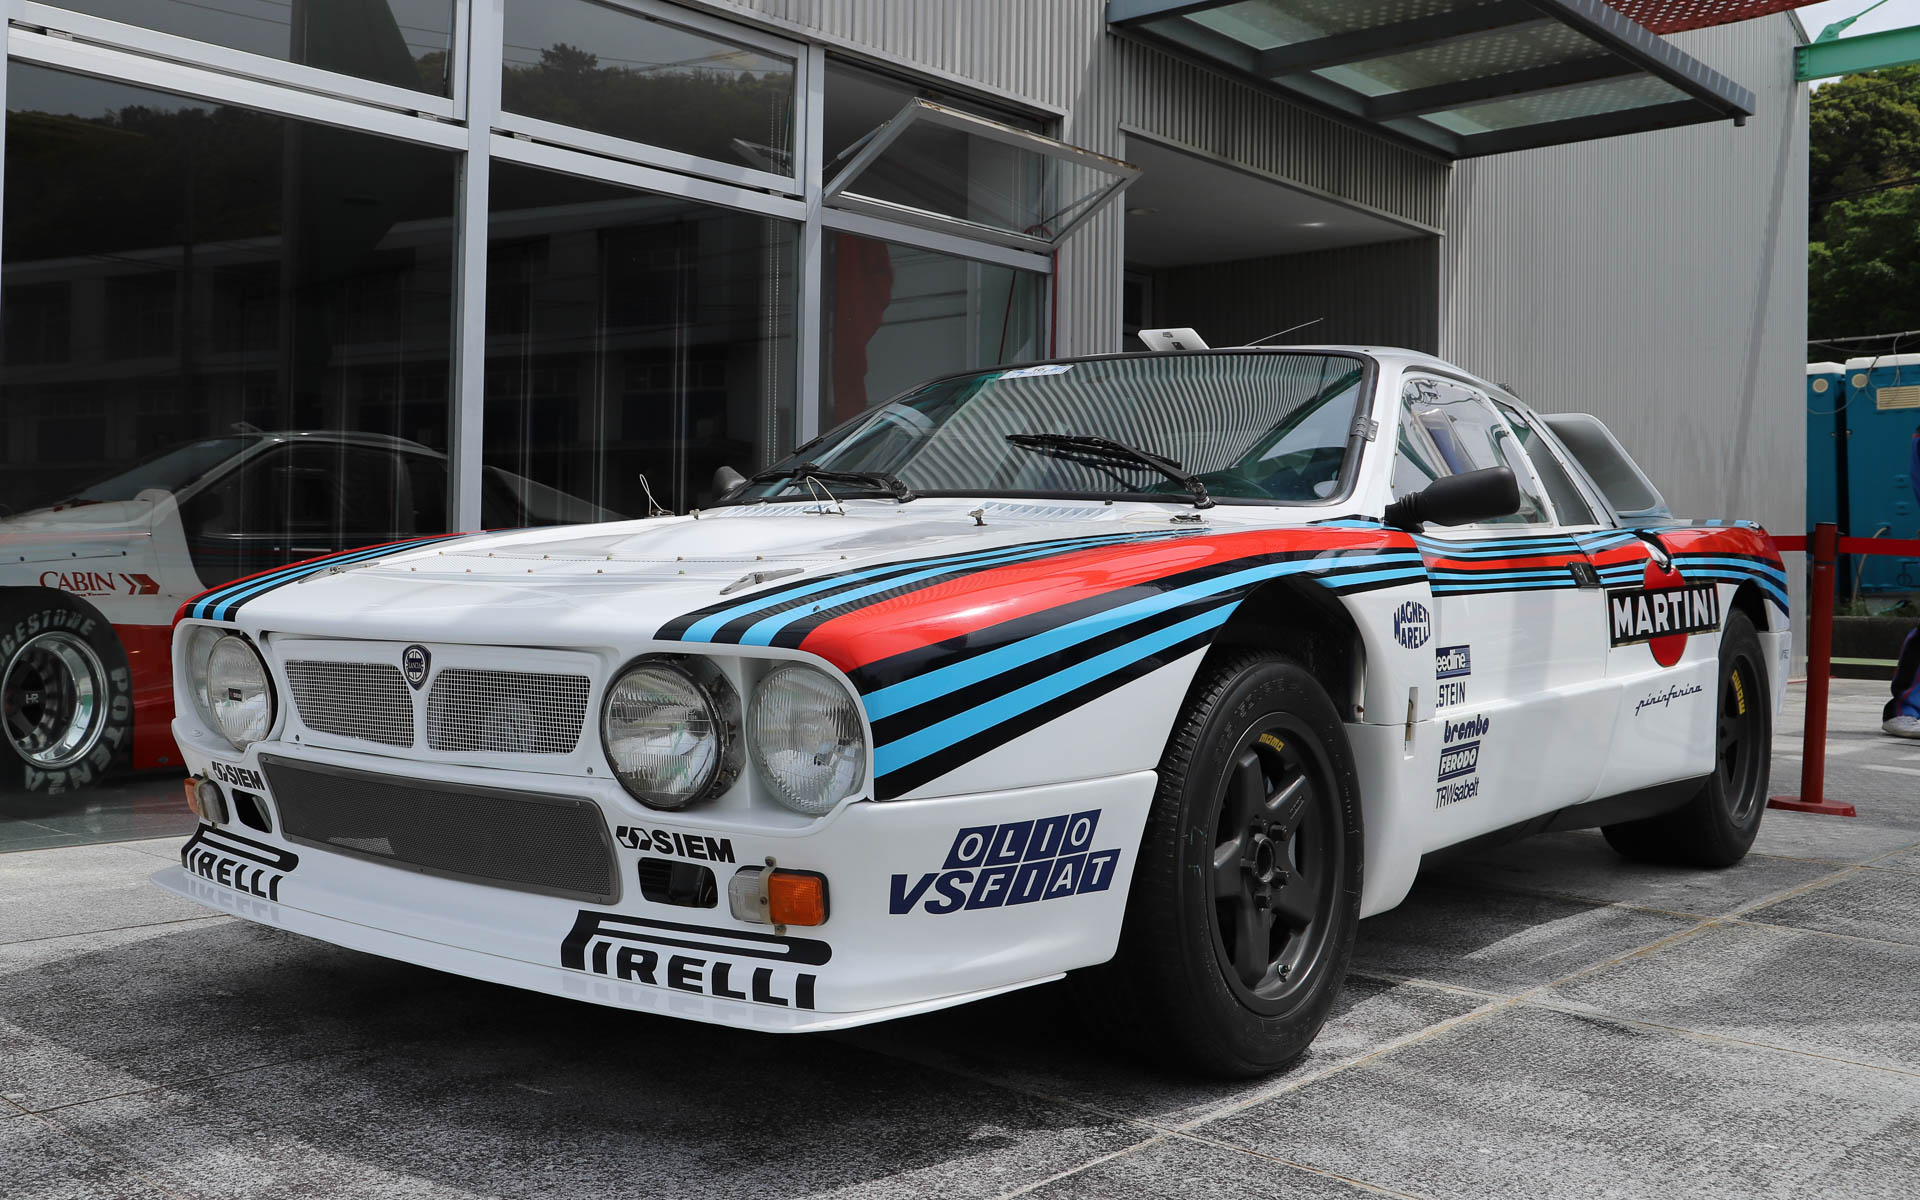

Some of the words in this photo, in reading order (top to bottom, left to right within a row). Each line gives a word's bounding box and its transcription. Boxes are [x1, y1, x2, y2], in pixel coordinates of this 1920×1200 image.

[39, 571, 117, 591] CABIN
[1393, 600, 1430, 627] MAGNETI
[1613, 588, 1717, 639] MARTINI
[1393, 622, 1431, 650] MARELLI
[1436, 681, 1466, 708] STEIN
[1635, 684, 1703, 716] pininfarina
[25, 667, 129, 795] POTENZA
[1444, 714, 1490, 744] brembo
[227, 765, 266, 790] SIEM
[1440, 748, 1477, 775] FERODO
[653, 829, 736, 863] SIEM
[956, 816, 1092, 862] OLIO
[181, 822, 299, 902] PIRELLI
[979, 856, 1112, 902] FIAT
[561, 910, 833, 1010] PIRELLI
